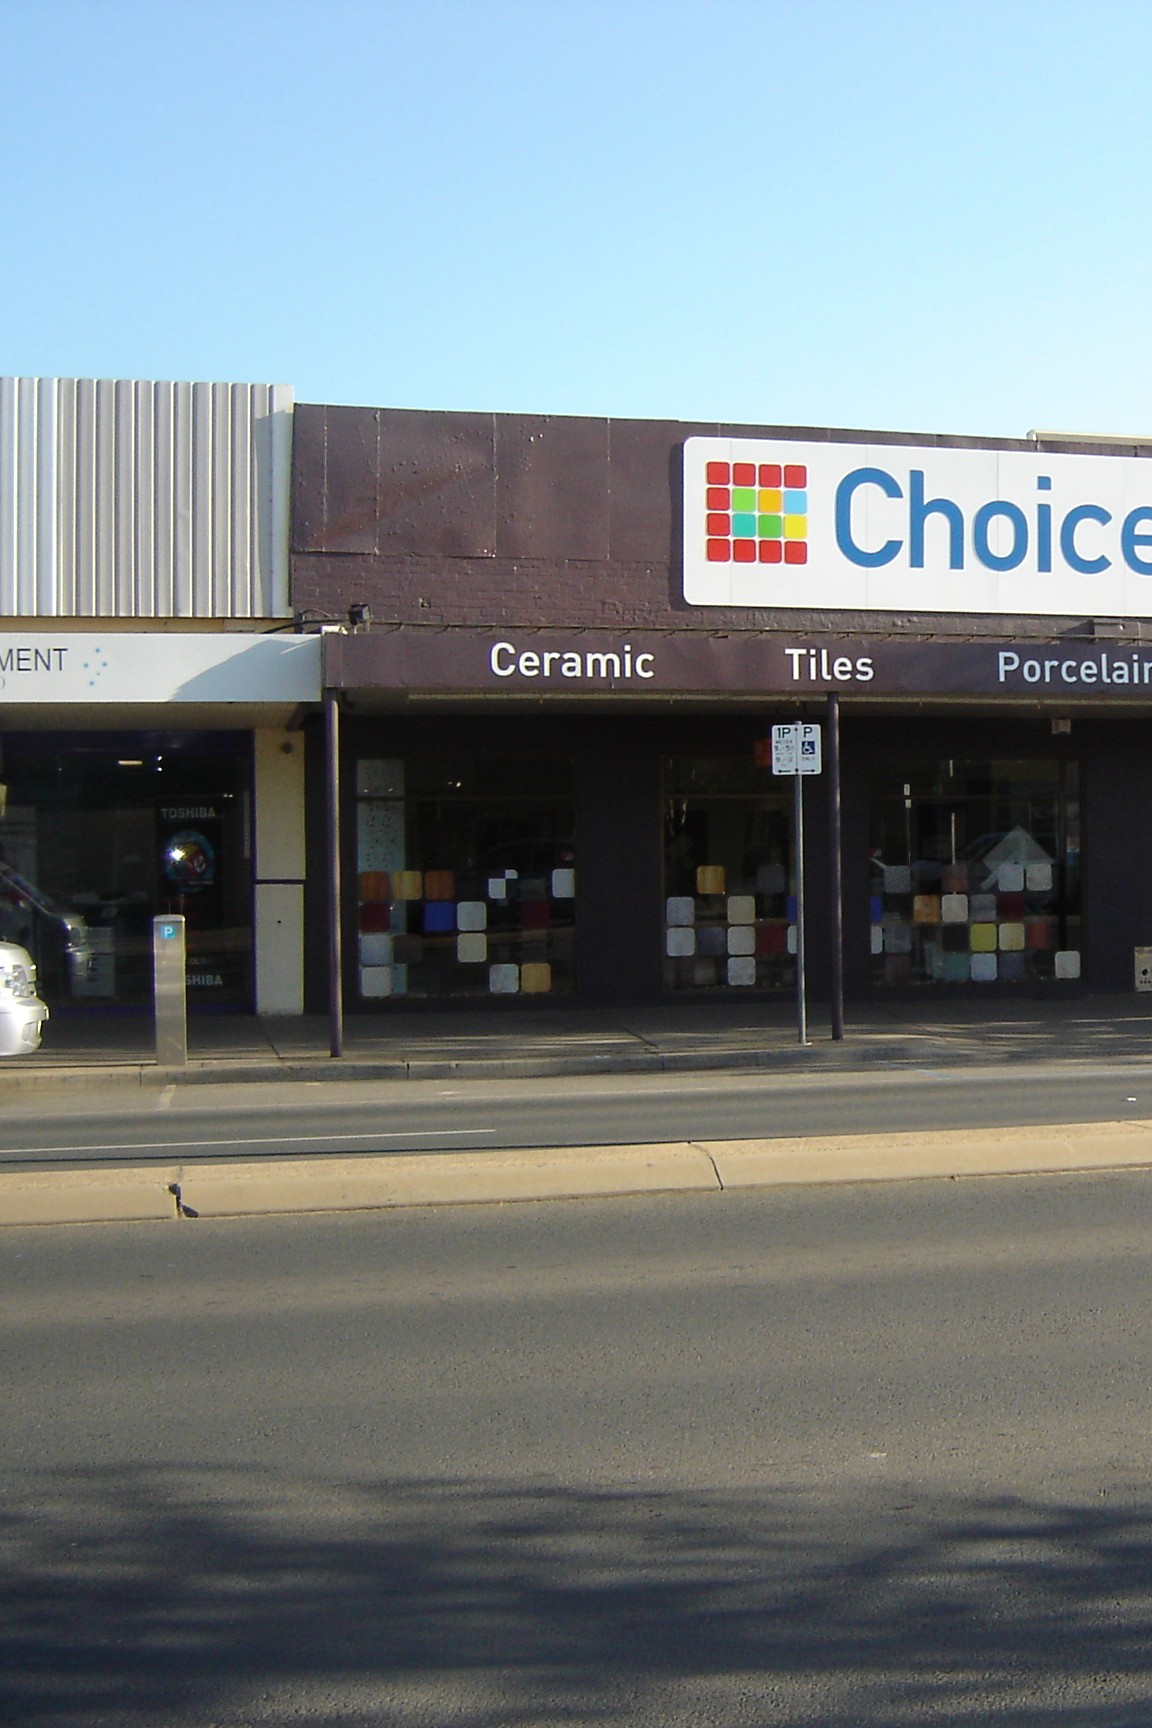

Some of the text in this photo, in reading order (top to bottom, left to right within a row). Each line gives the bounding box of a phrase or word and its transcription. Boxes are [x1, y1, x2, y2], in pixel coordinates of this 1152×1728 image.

[491, 642, 655, 678] Ceramic
[784, 648, 874, 681] Tiles
[777, 727, 791, 739] 1P
[803, 726, 813, 738] P
[160, 807, 216, 819] TOSHIBA
[185, 974, 223, 986] SHIBA
